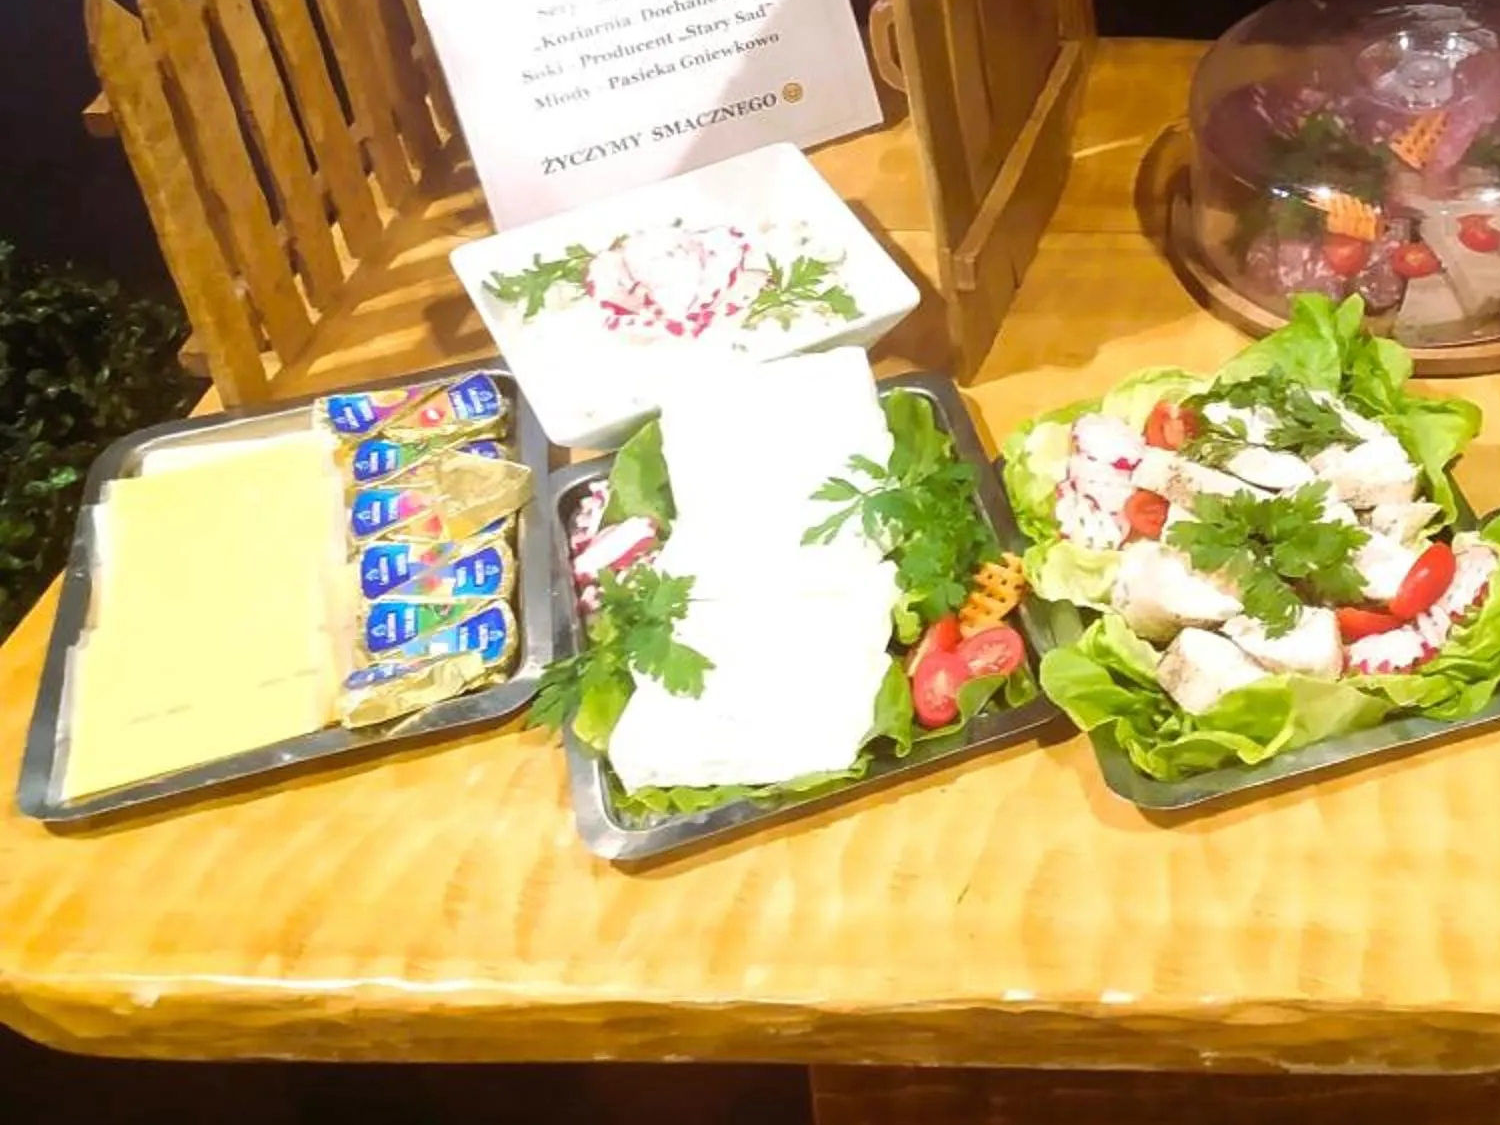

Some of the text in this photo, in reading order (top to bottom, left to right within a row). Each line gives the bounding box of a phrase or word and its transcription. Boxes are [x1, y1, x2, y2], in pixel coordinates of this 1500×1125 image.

[579, 32, 674, 69] Producent
[607, 62, 676, 91] Pasieka
[678, 32, 781, 71] Gniewkowo
[540, 92, 779, 176] ŻYCZYMY SMACZNEGO
